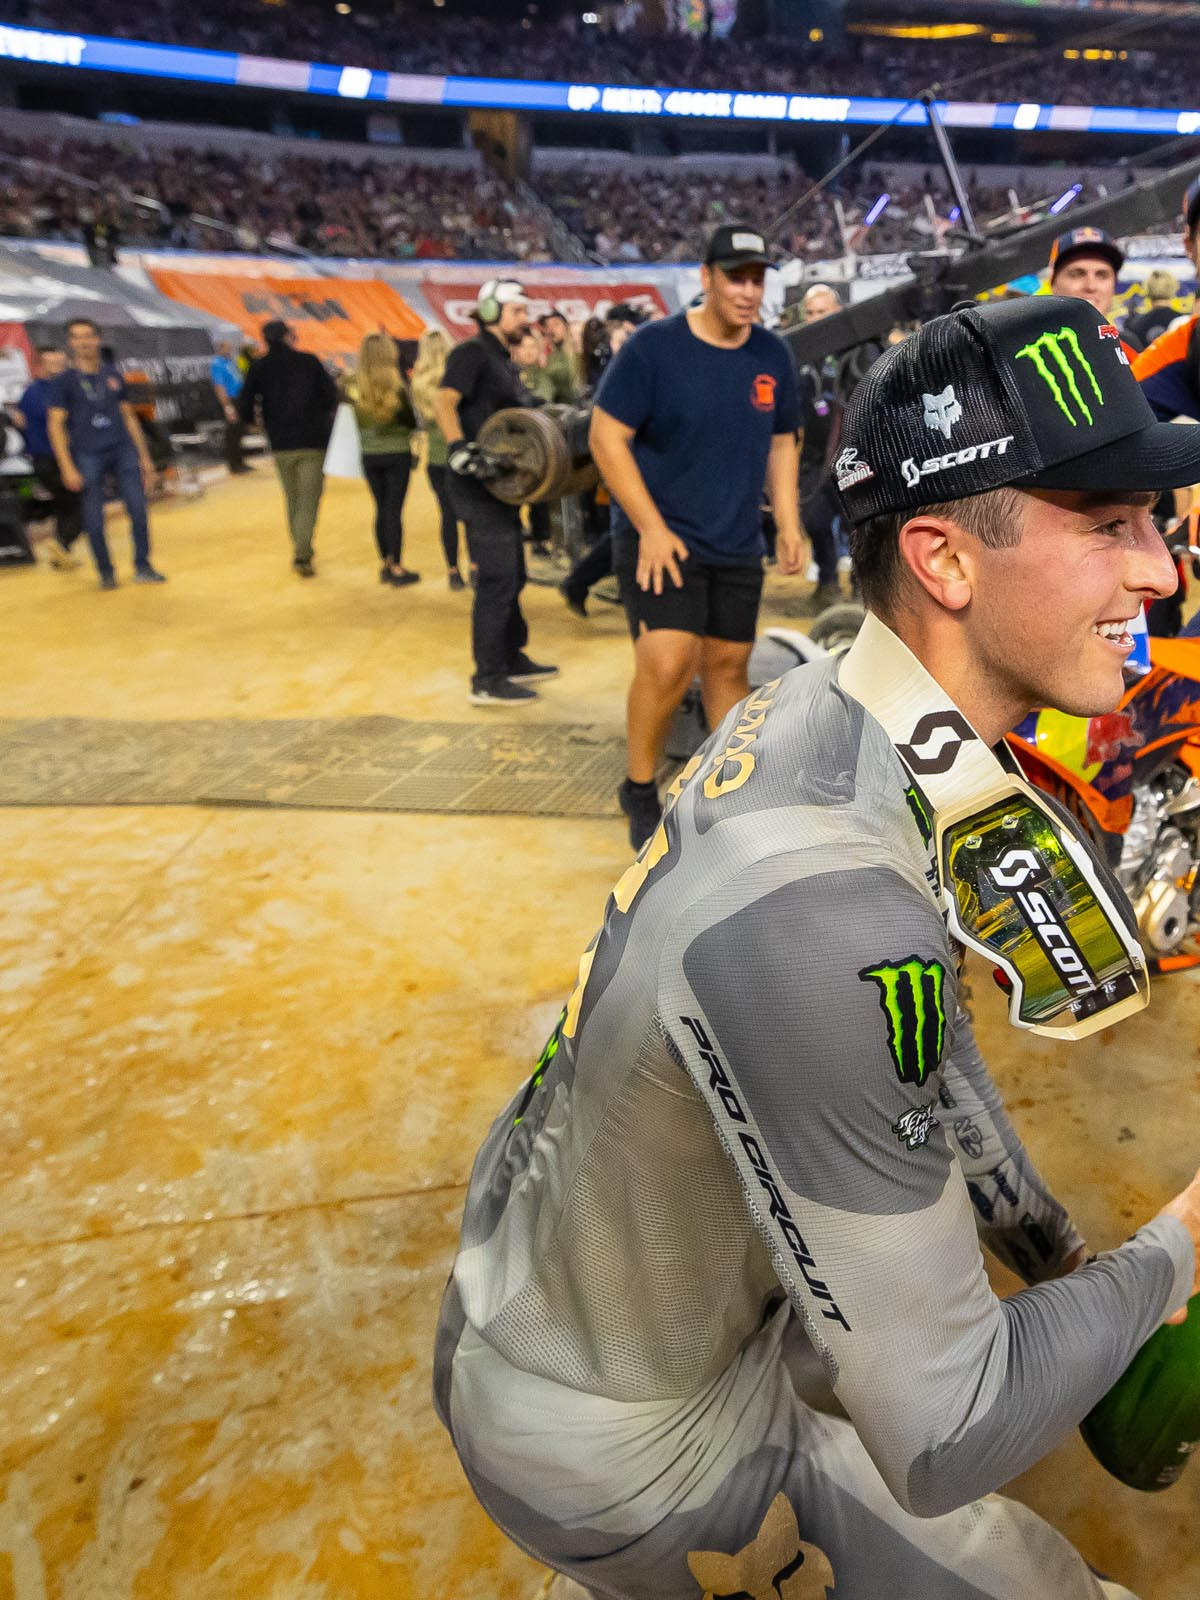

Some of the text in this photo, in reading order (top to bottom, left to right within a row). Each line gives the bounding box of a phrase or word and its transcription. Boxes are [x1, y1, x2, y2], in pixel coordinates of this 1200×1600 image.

[919, 435, 1014, 476] SCOTT
[1016, 890, 1097, 996] SCOTT
[679, 1015, 852, 1333] PRO CIRCUIT
